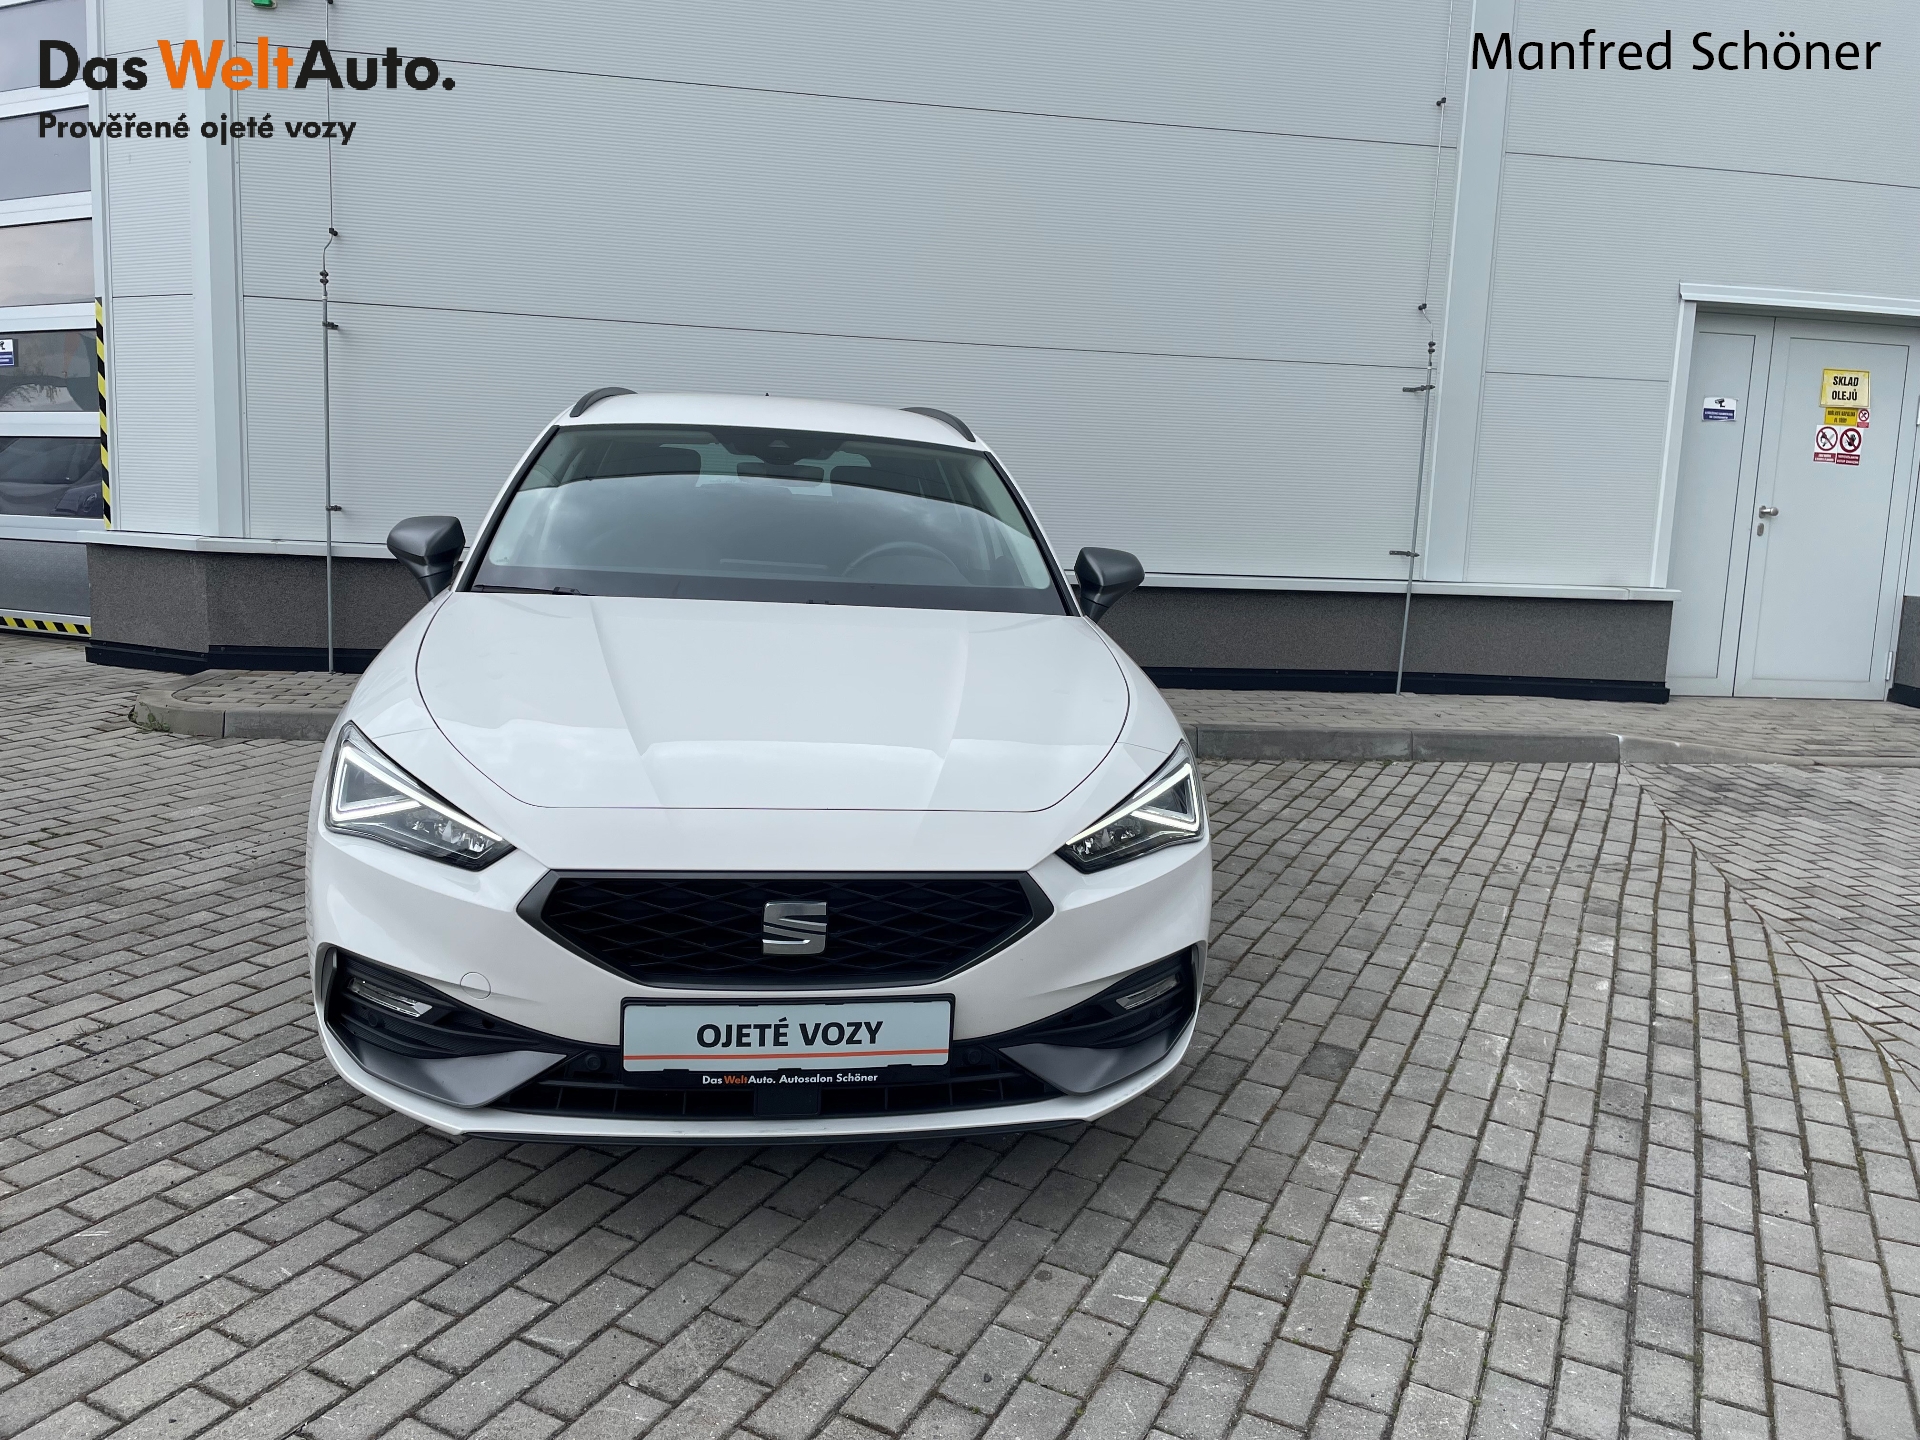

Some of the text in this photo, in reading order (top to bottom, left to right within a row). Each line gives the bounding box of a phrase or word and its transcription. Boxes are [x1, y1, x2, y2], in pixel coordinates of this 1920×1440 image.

[1832, 375, 1859, 387] SKLAD
[1831, 388, 1858, 401] OLEJŮ
[696, 1017, 884, 1049] OJETÉ VOZY
[702, 1075, 723, 1085] Das
[778, 1074, 833, 1085] Autosalon
[836, 1072, 879, 1083] Schöner
